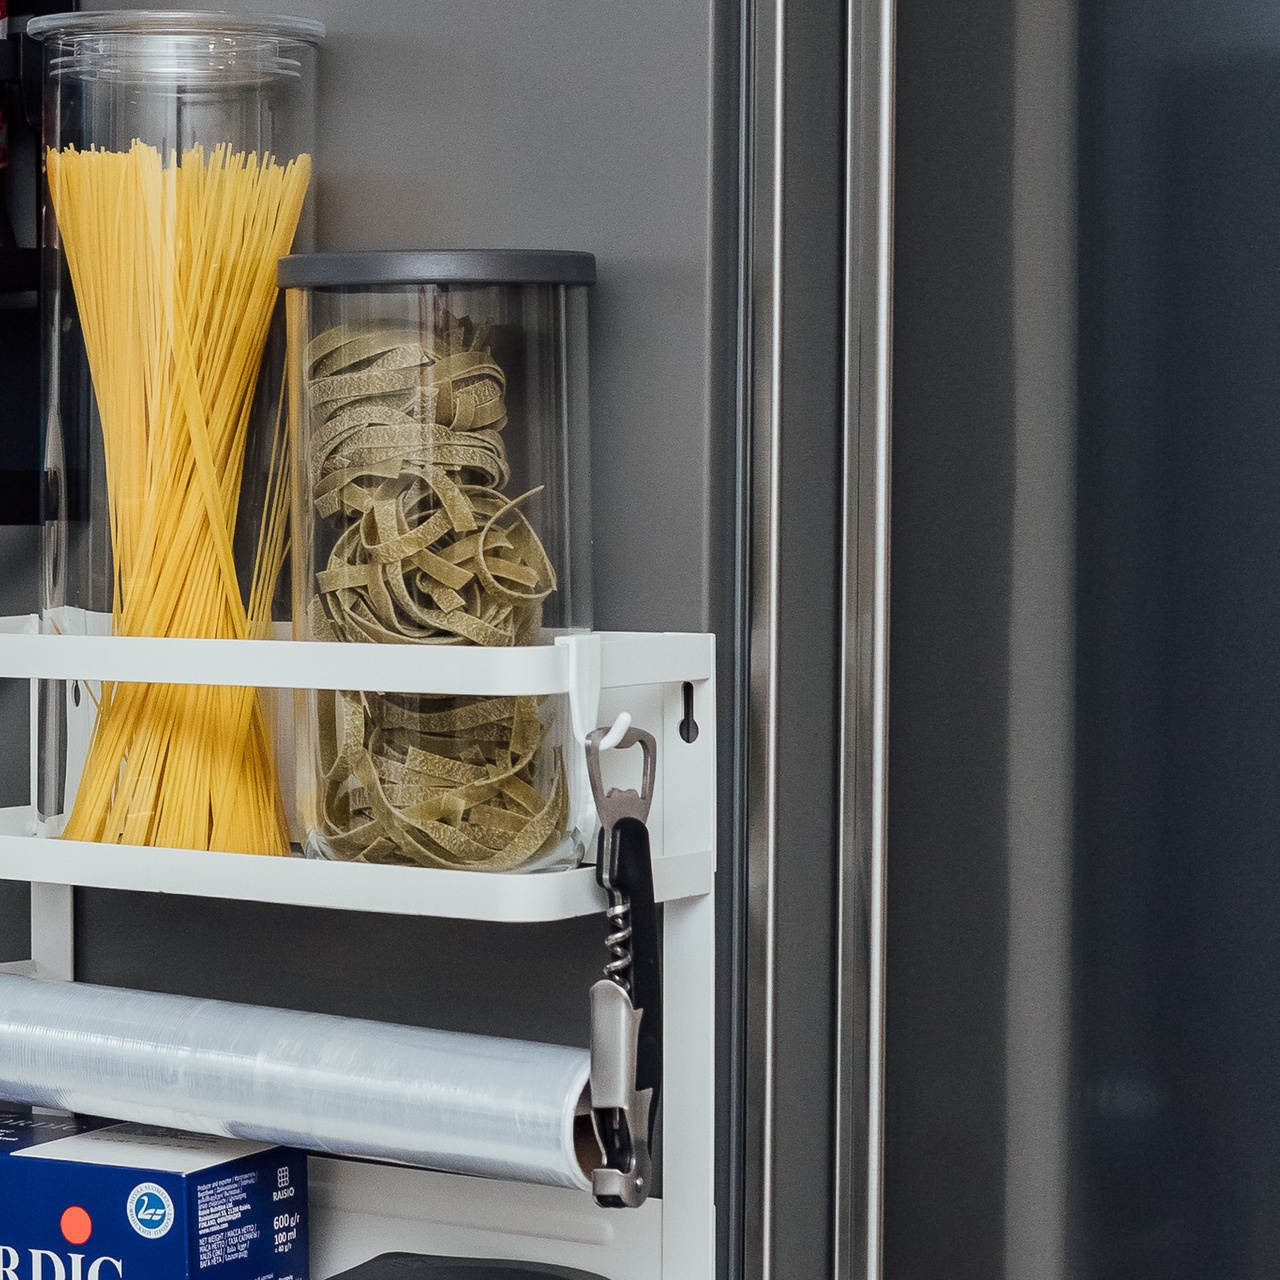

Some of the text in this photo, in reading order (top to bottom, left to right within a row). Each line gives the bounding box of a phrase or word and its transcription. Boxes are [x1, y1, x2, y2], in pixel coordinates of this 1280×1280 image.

[272, 1187, 295, 1201] RAISIO
[273, 1214, 289, 1230] 600
[274, 1232, 287, 1245] 100
